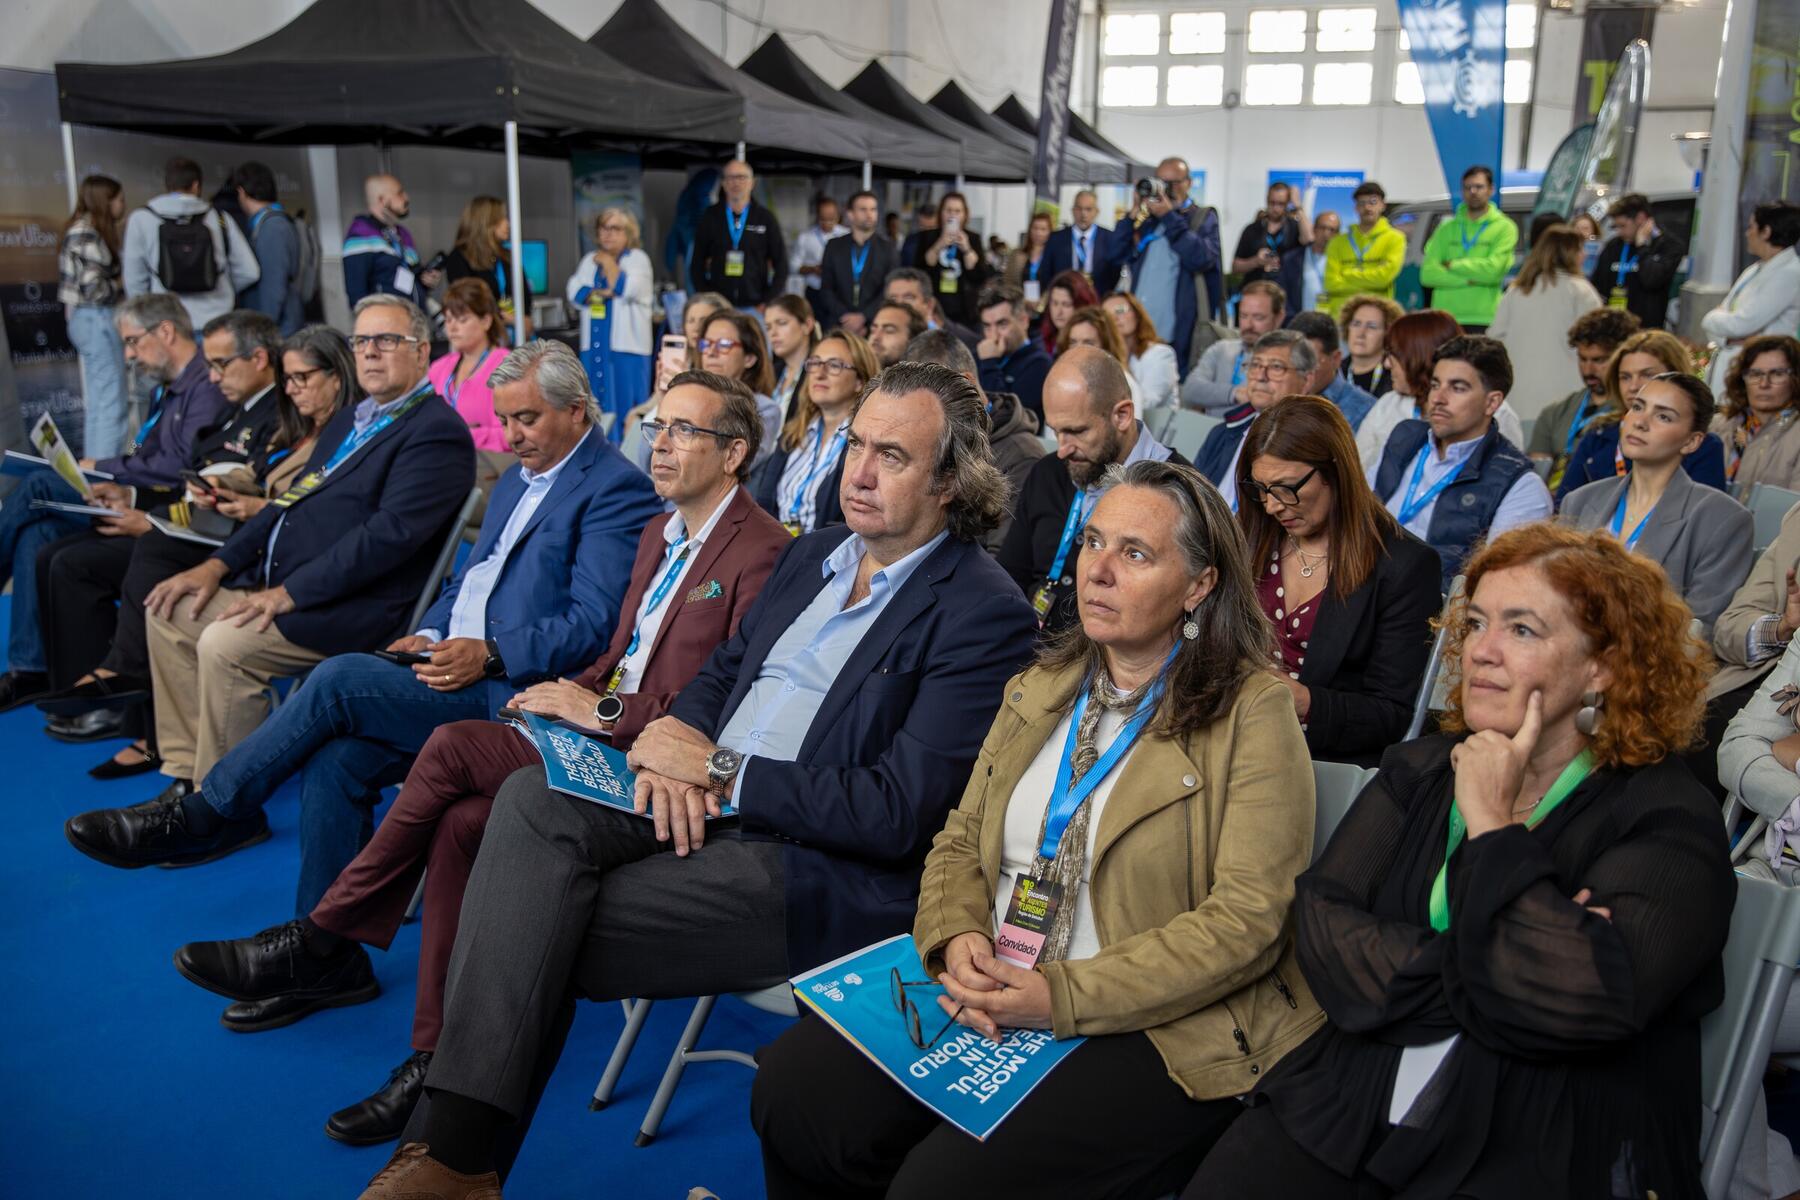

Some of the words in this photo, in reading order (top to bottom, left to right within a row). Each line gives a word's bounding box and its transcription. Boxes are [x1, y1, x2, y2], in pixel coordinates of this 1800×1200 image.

[546, 730, 572, 761] MOST
[586, 742, 616, 777] WORLD
[561, 760, 582, 782] THE
[582, 753, 600, 769] IN
[589, 766, 614, 795] BAYS
[607, 777, 628, 799] THE
[998, 935, 1037, 956] Convidado
[909, 1031, 981, 1079] WORLD
[946, 1028, 1034, 1095] EAUTIFUL
[958, 1047, 987, 1067] IN
[971, 1053, 1028, 1104] MOST
